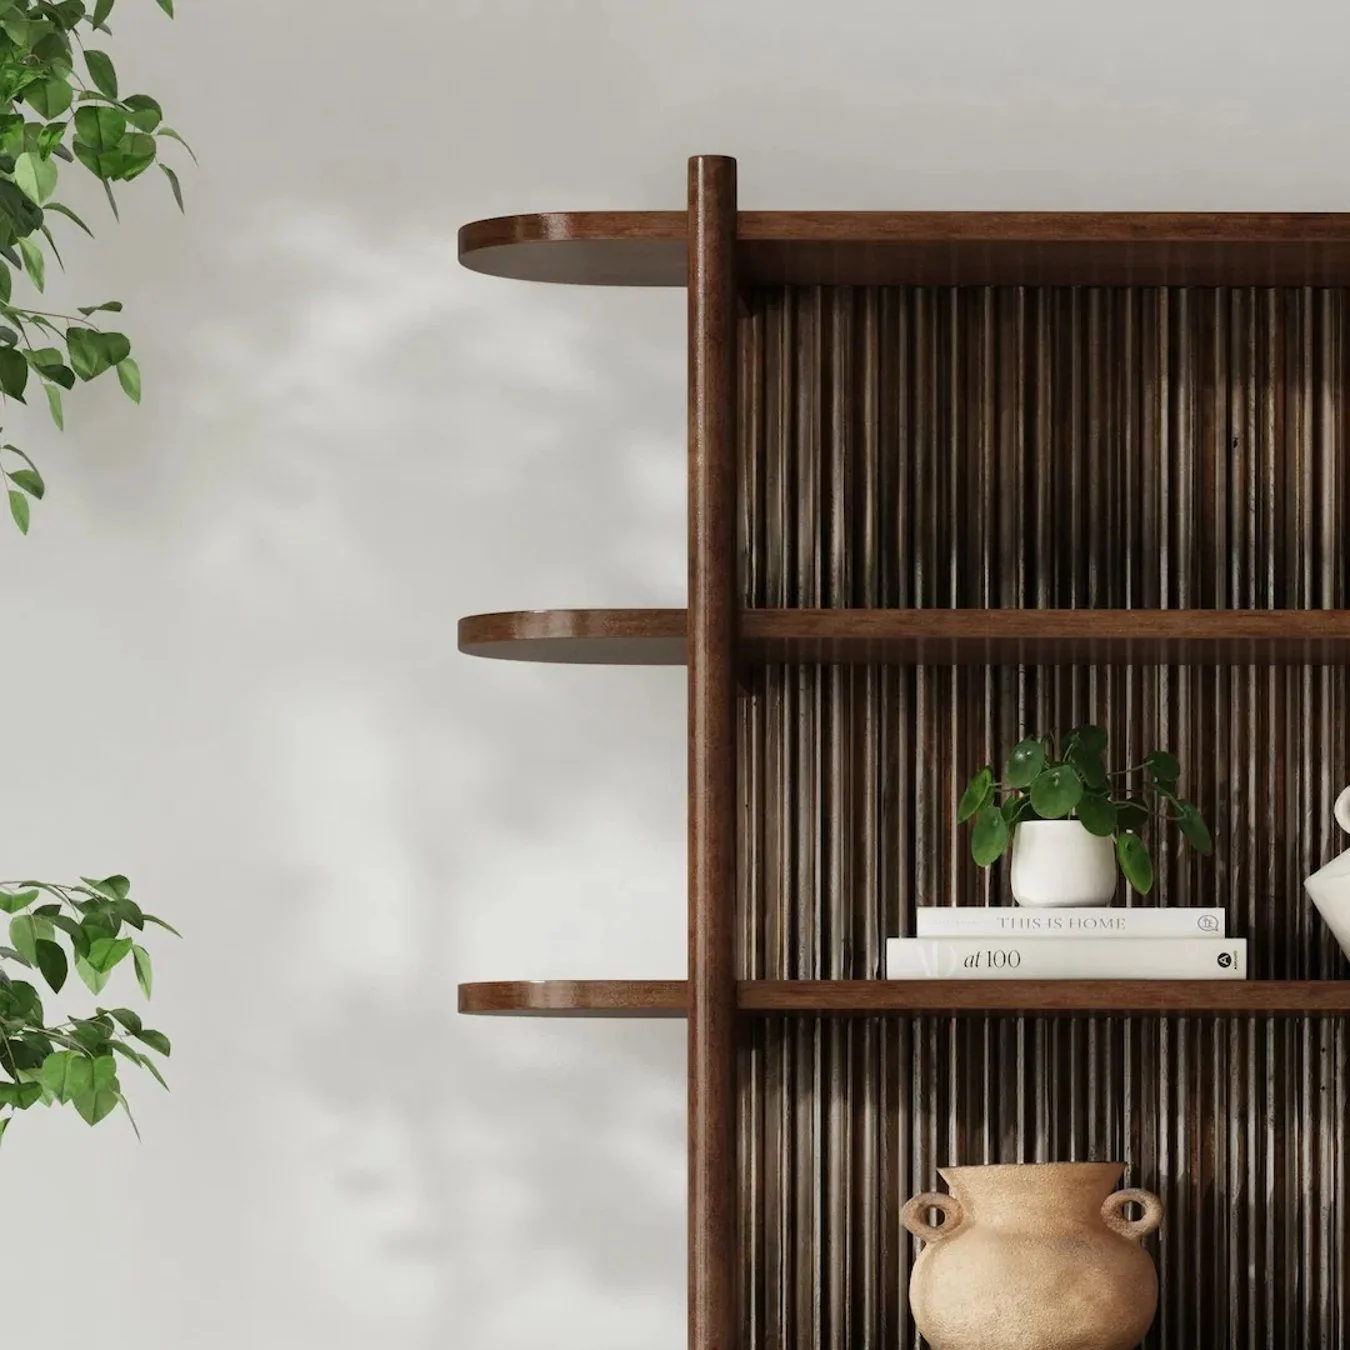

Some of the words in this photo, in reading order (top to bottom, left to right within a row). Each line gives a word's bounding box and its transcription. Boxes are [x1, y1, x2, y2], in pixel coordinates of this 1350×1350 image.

[996, 917, 1042, 929] THIS
[1047, 917, 1063, 929] IS
[1068, 917, 1127, 929] HOME
[963, 950, 982, 969] at
[987, 950, 1021, 969] 100
